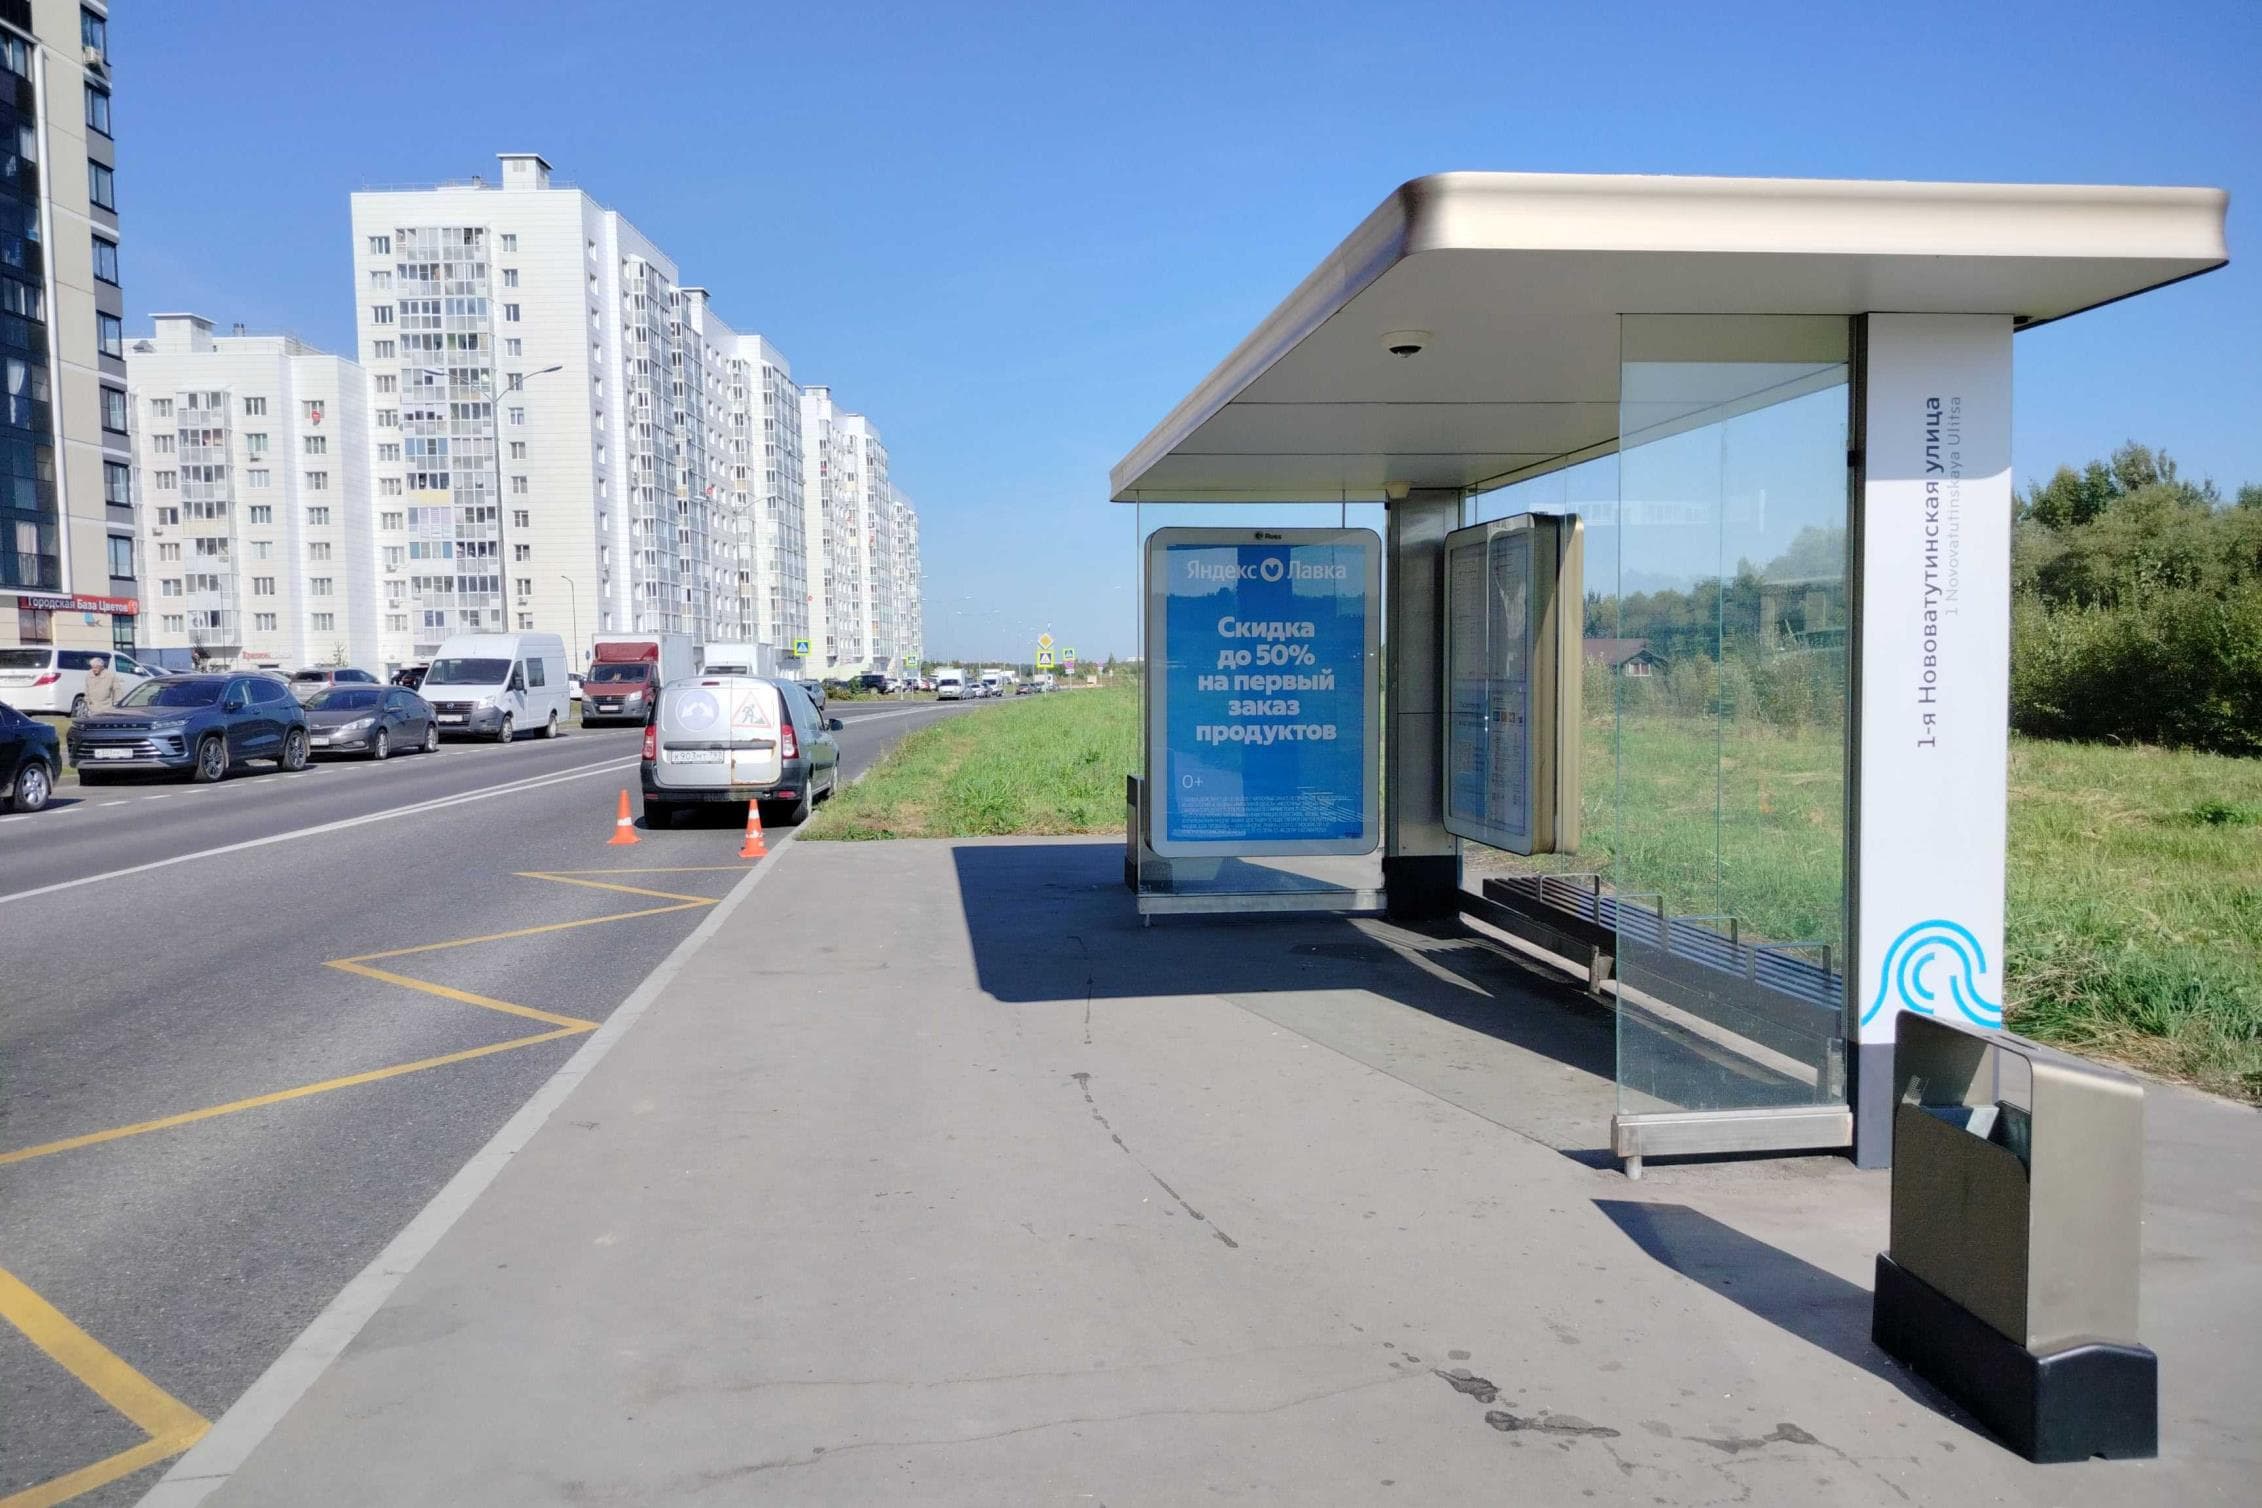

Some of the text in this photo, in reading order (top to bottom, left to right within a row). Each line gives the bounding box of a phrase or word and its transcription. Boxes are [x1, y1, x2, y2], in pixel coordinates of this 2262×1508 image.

[1947, 396, 1961, 445] Ulitsa
[1187, 560, 1347, 581] Яндекс Лавка
[1917, 397, 1944, 747] 1-я Нововатутинская улица
[28, 597, 75, 609] Городская
[77, 598, 97, 610] База
[1218, 616, 1315, 641] Скидка
[1217, 644, 1316, 670] до 50%
[1198, 668, 1335, 695] на первый
[1228, 699, 1300, 716] заказ
[1196, 724, 1337, 746] продуктов
[1182, 775, 1203, 789] 0+
